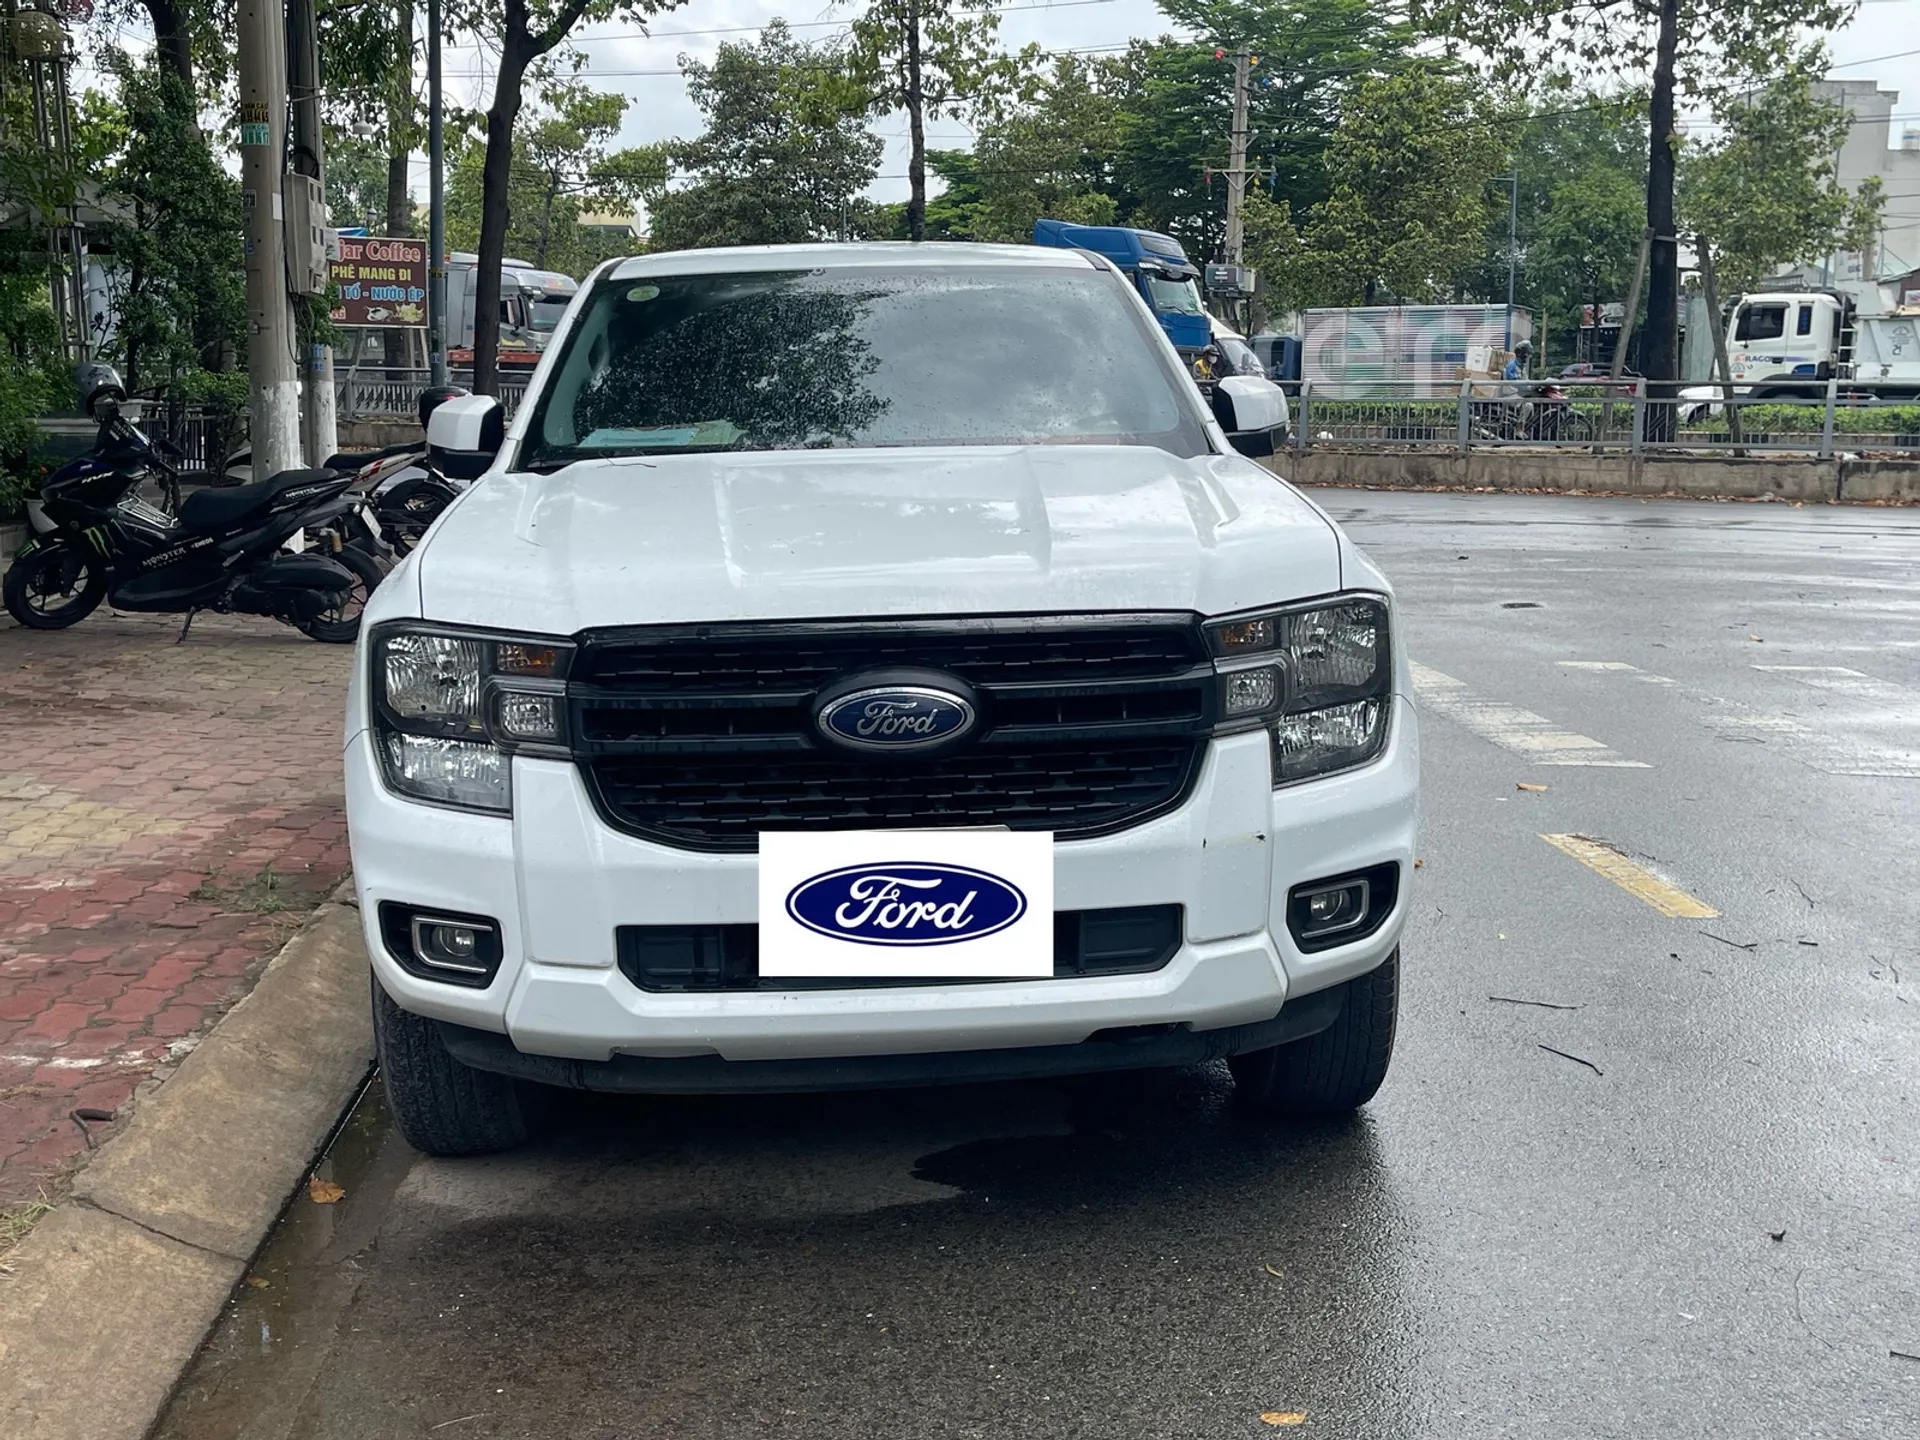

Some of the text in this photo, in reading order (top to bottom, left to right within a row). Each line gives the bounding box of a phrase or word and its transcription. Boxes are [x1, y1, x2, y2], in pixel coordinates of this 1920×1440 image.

[365, 241, 421, 262] Coffee
[331, 264, 355, 279] PHÊ
[358, 267, 396, 280] MANG
[344, 282, 361, 300] TỐ
[142, 547, 187, 567] MONSTER
[856, 701, 938, 735] Ford
